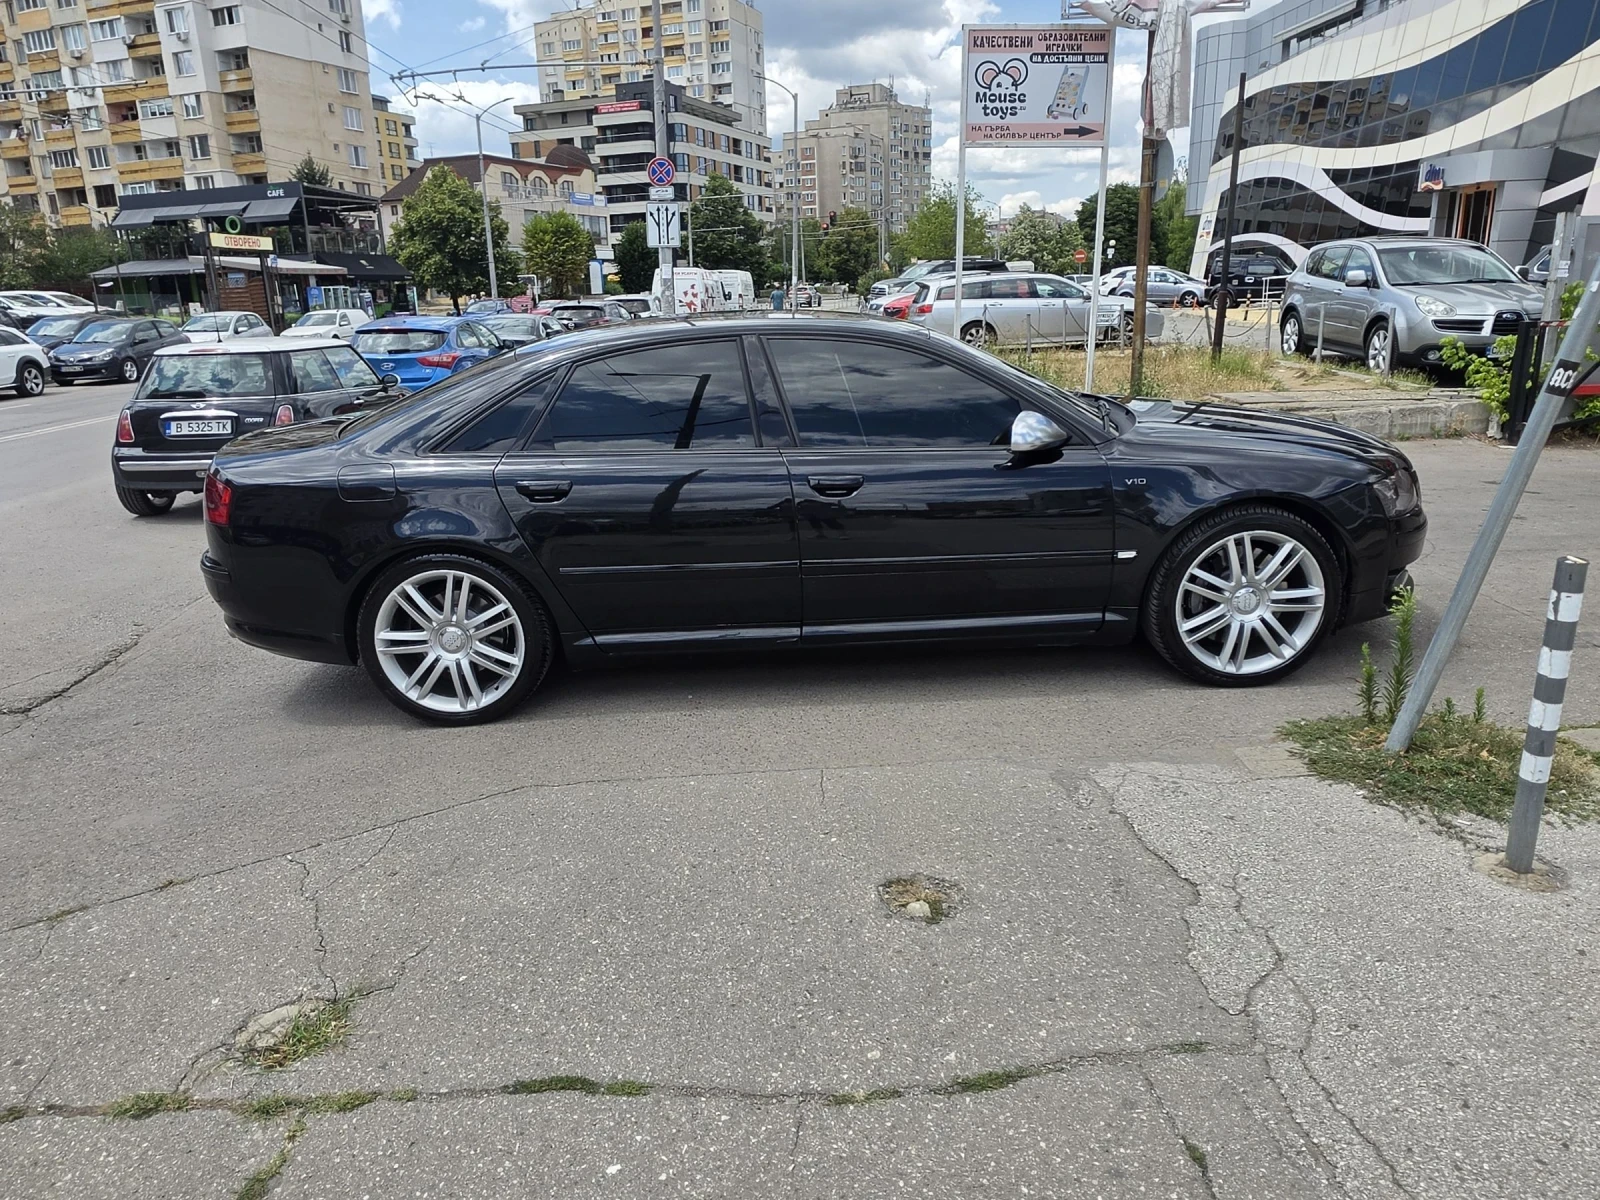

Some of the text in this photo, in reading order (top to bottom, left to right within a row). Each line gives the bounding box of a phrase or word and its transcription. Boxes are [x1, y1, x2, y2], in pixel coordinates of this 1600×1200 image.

[973, 35, 1033, 49] КАЧЕСТВЕНИ
[1037, 32, 1106, 42] ОБРАЗОВАТЕЛНИ
[1045, 43, 1083, 52] ИГРАЧКИ
[1032, 54, 1105, 64] НА ДОСТЪПНИ ЦЕНИ
[975, 91, 1027, 104] Mouse
[1029, 132, 1062, 140] ЦЕНТЪР
[224, 235, 262, 248] ОТВОРЕНО
[175, 421, 229, 433] B 5325 TK
[1124, 477, 1147, 485] V10
